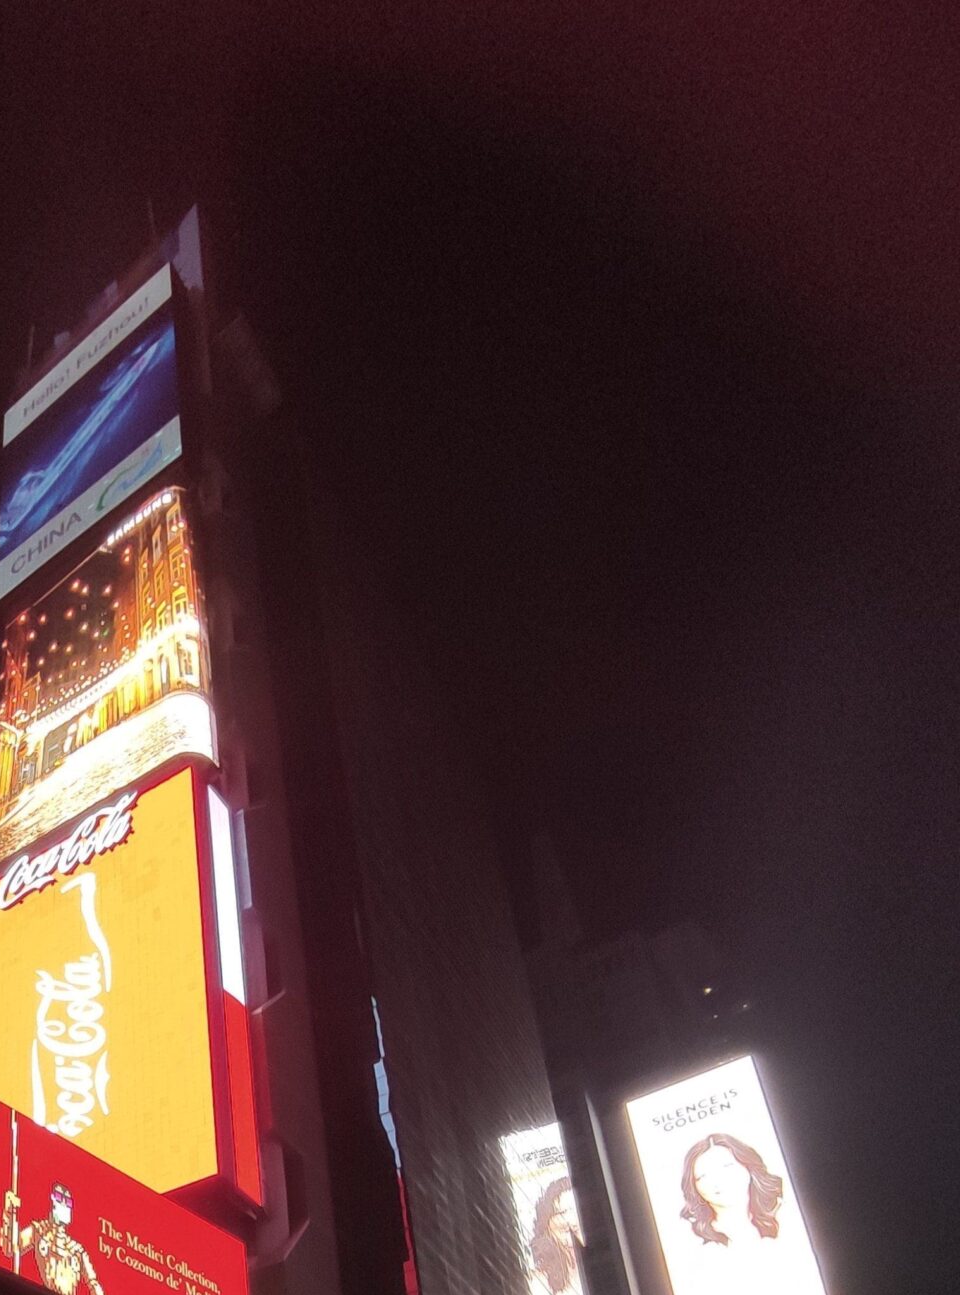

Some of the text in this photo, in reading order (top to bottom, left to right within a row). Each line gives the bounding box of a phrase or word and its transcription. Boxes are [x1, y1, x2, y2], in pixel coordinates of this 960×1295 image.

[76, 296, 149, 366] Fuzhou!
[11, 511, 82, 574] CHINA
[652, 1088, 738, 1126] SILENCE IS
[663, 1101, 732, 1132] GOLDEN
[98, 1217, 221, 1295] The Medici Collection,
[99, 1236, 113, 1259] by
[116, 1246, 164, 1282] Cozomo
